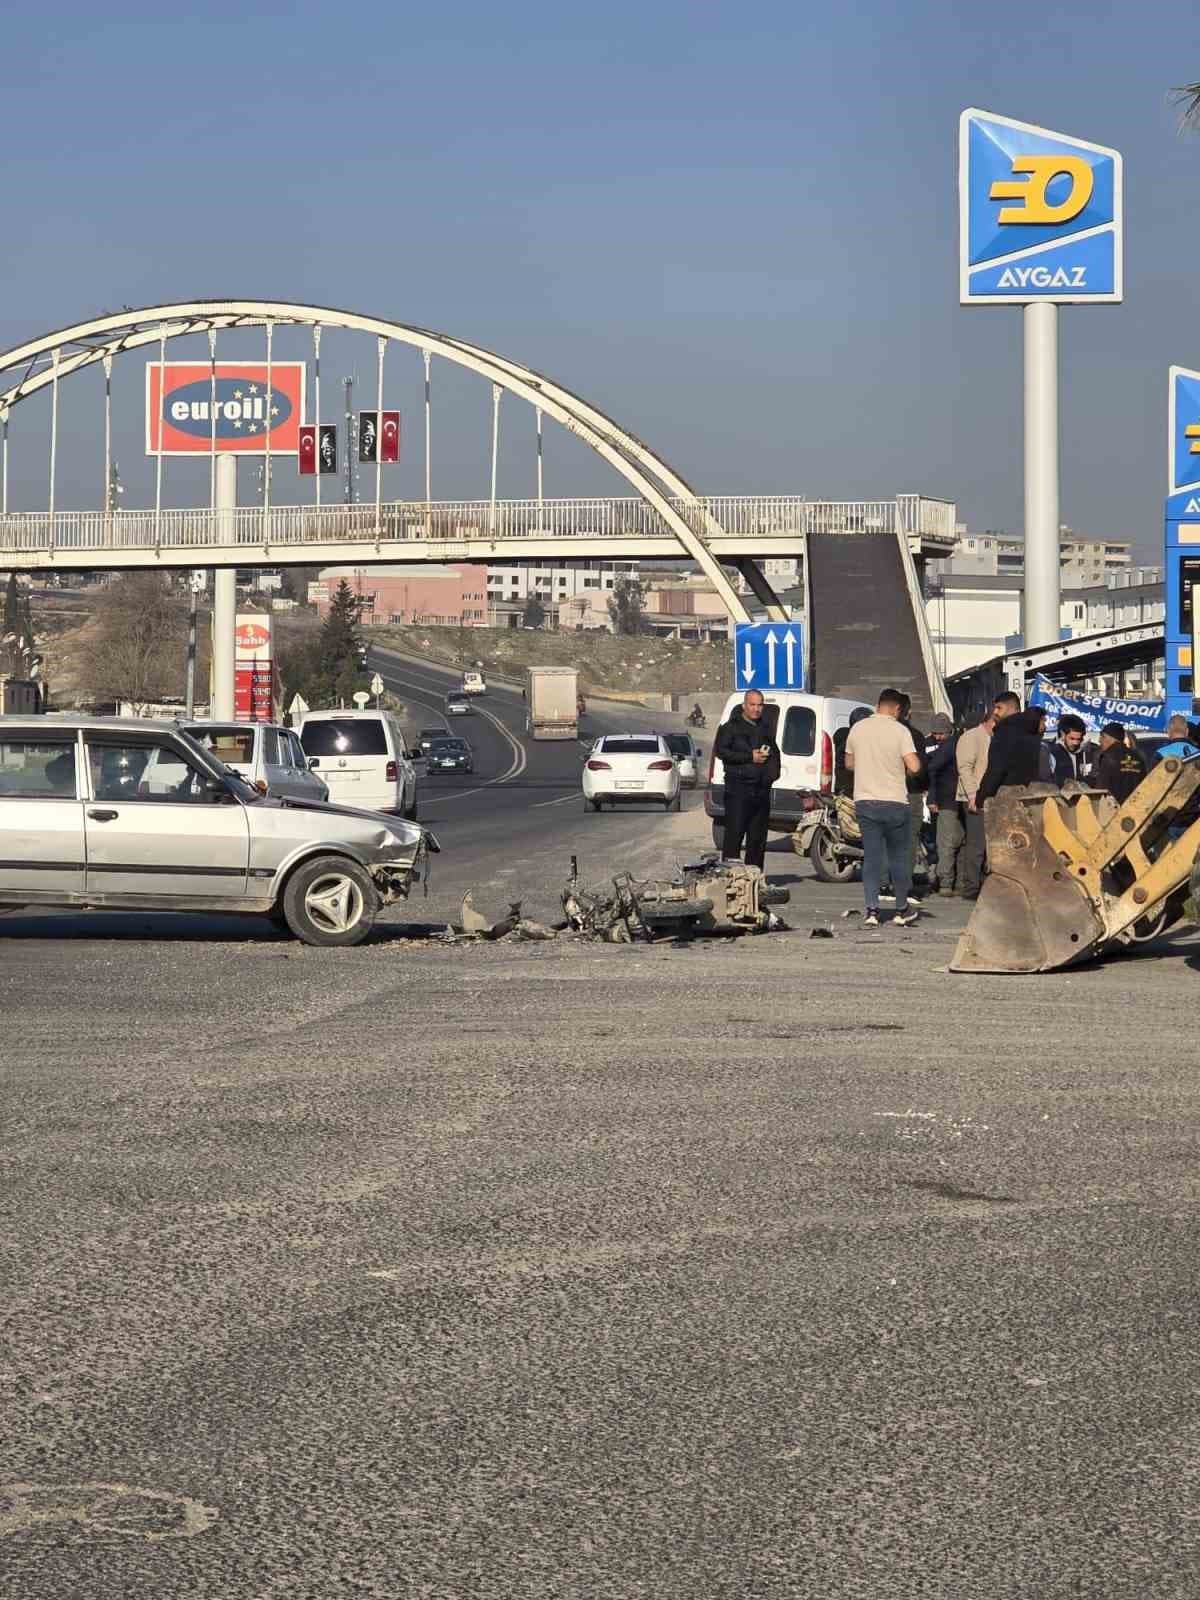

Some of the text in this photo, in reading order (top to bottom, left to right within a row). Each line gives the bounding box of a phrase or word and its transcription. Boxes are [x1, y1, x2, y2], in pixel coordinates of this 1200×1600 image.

[997, 266, 1087, 288] AYGAZ
[171, 398, 263, 420] euroil
[1184, 497, 1200, 513] A
